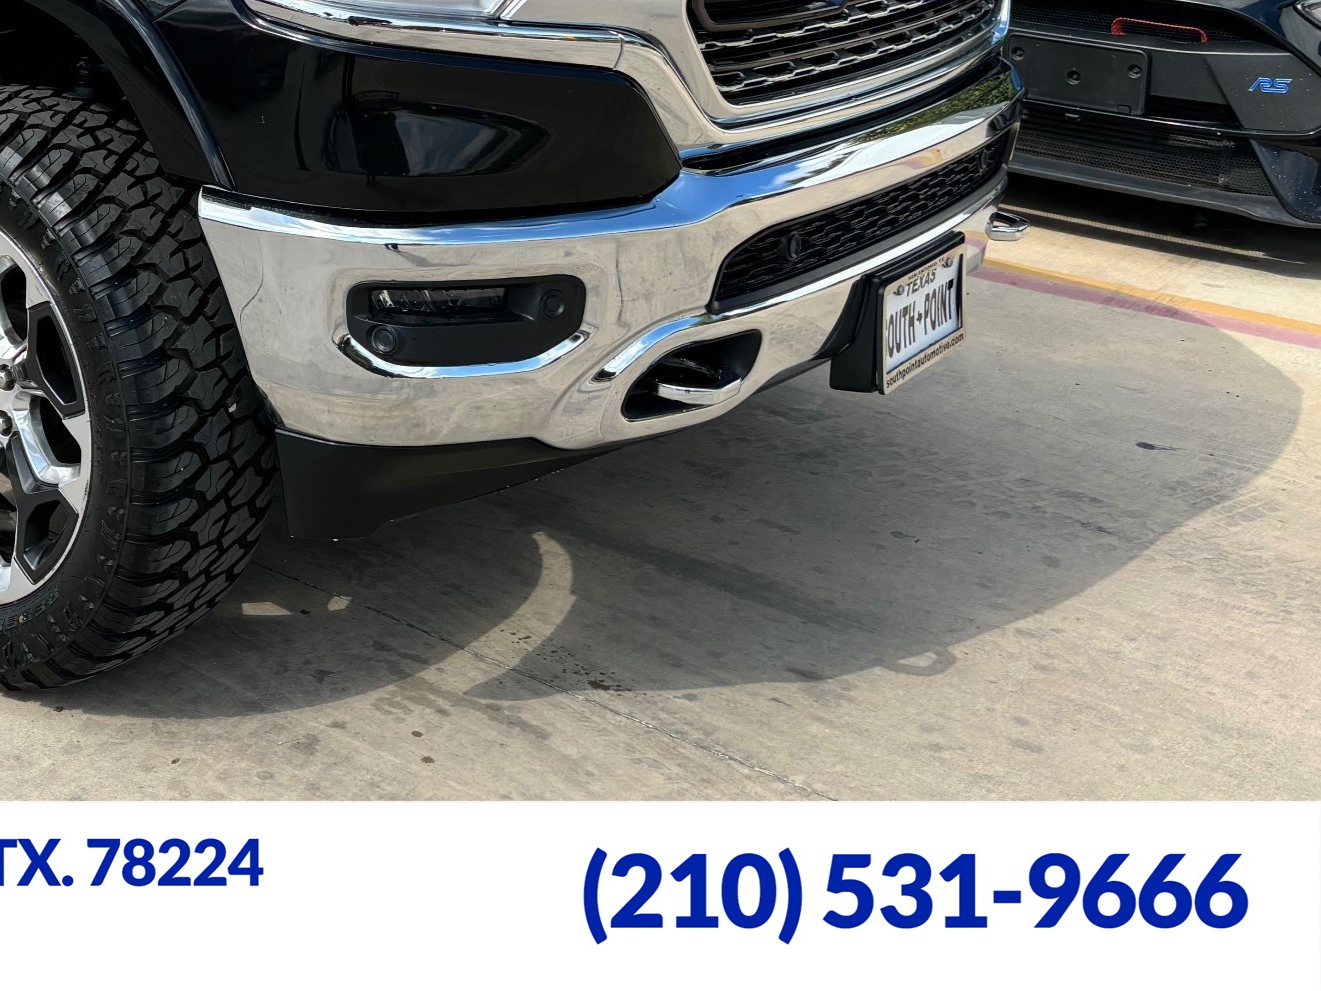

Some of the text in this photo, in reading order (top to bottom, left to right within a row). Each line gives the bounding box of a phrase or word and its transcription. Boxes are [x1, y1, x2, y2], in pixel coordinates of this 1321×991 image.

[1248, 77, 1293, 94] RS
[905, 269, 937, 297] TEXAS
[886, 277, 955, 358] OUTH POINT
[886, 333, 965, 389] southpointautomotive.com
